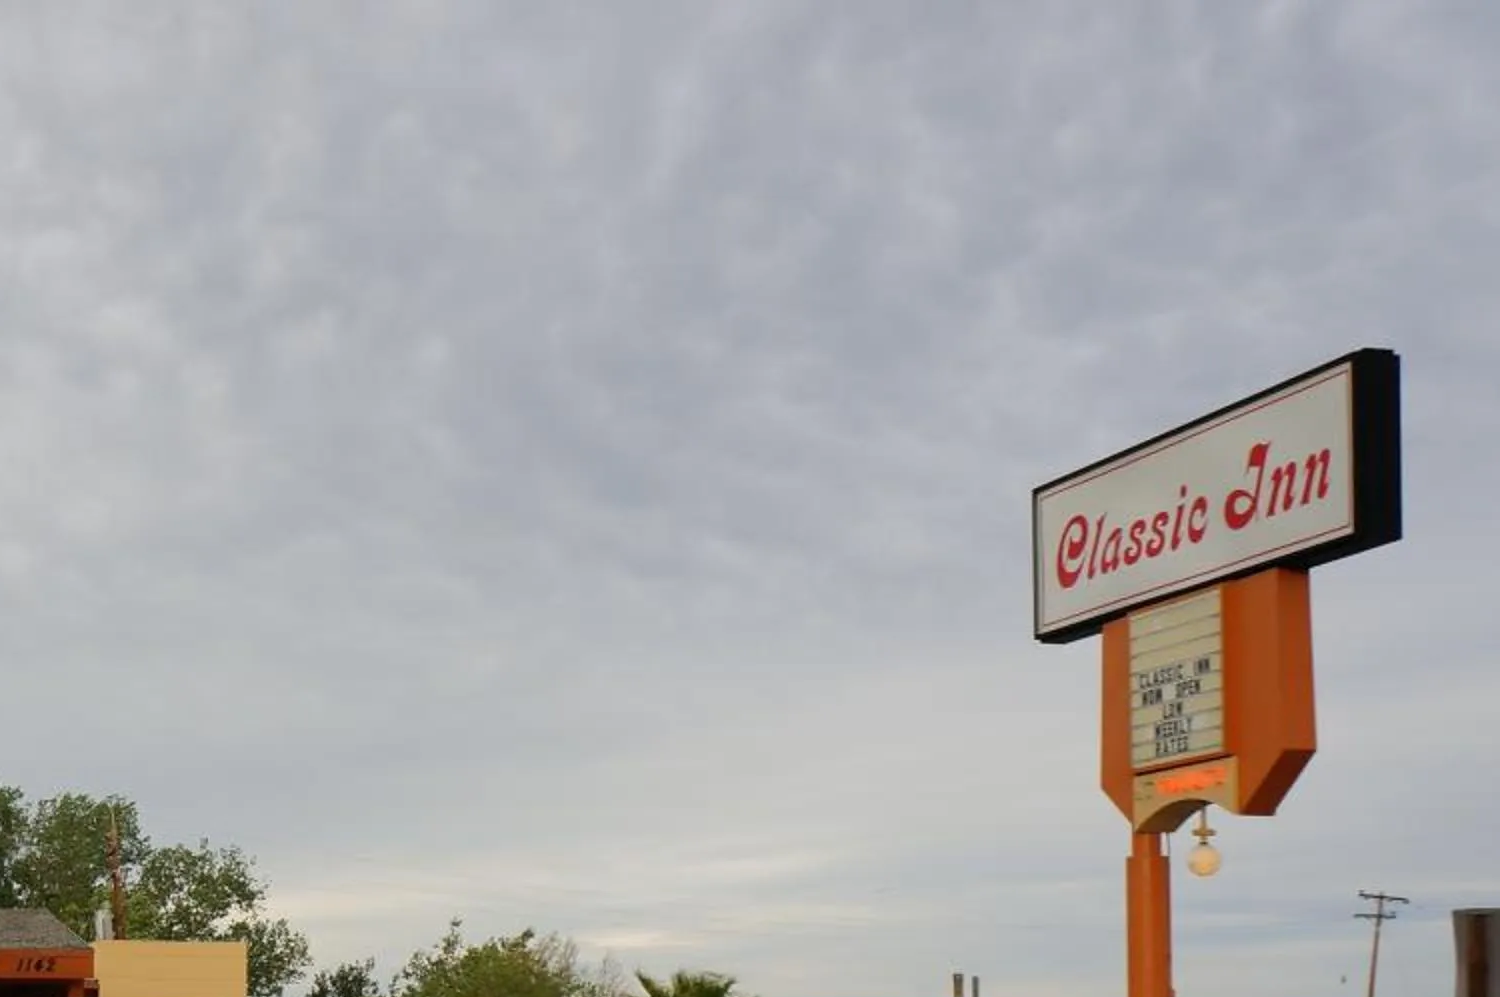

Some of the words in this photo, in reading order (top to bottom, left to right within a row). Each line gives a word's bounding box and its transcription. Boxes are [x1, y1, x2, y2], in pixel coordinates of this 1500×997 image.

[1056, 485, 1209, 589] Classic
[1223, 440, 1331, 531] Inn
[1139, 664, 1184, 690] CLASSIC
[1194, 658, 1211, 675] INN
[1142, 688, 1162, 705] NOW
[1176, 679, 1201, 698] OPEN
[1163, 702, 1183, 719] LOW
[1155, 716, 1191, 739] WEEKLY
[1156, 736, 1188, 755] RATES
[16, 957, 56, 972] 1142
